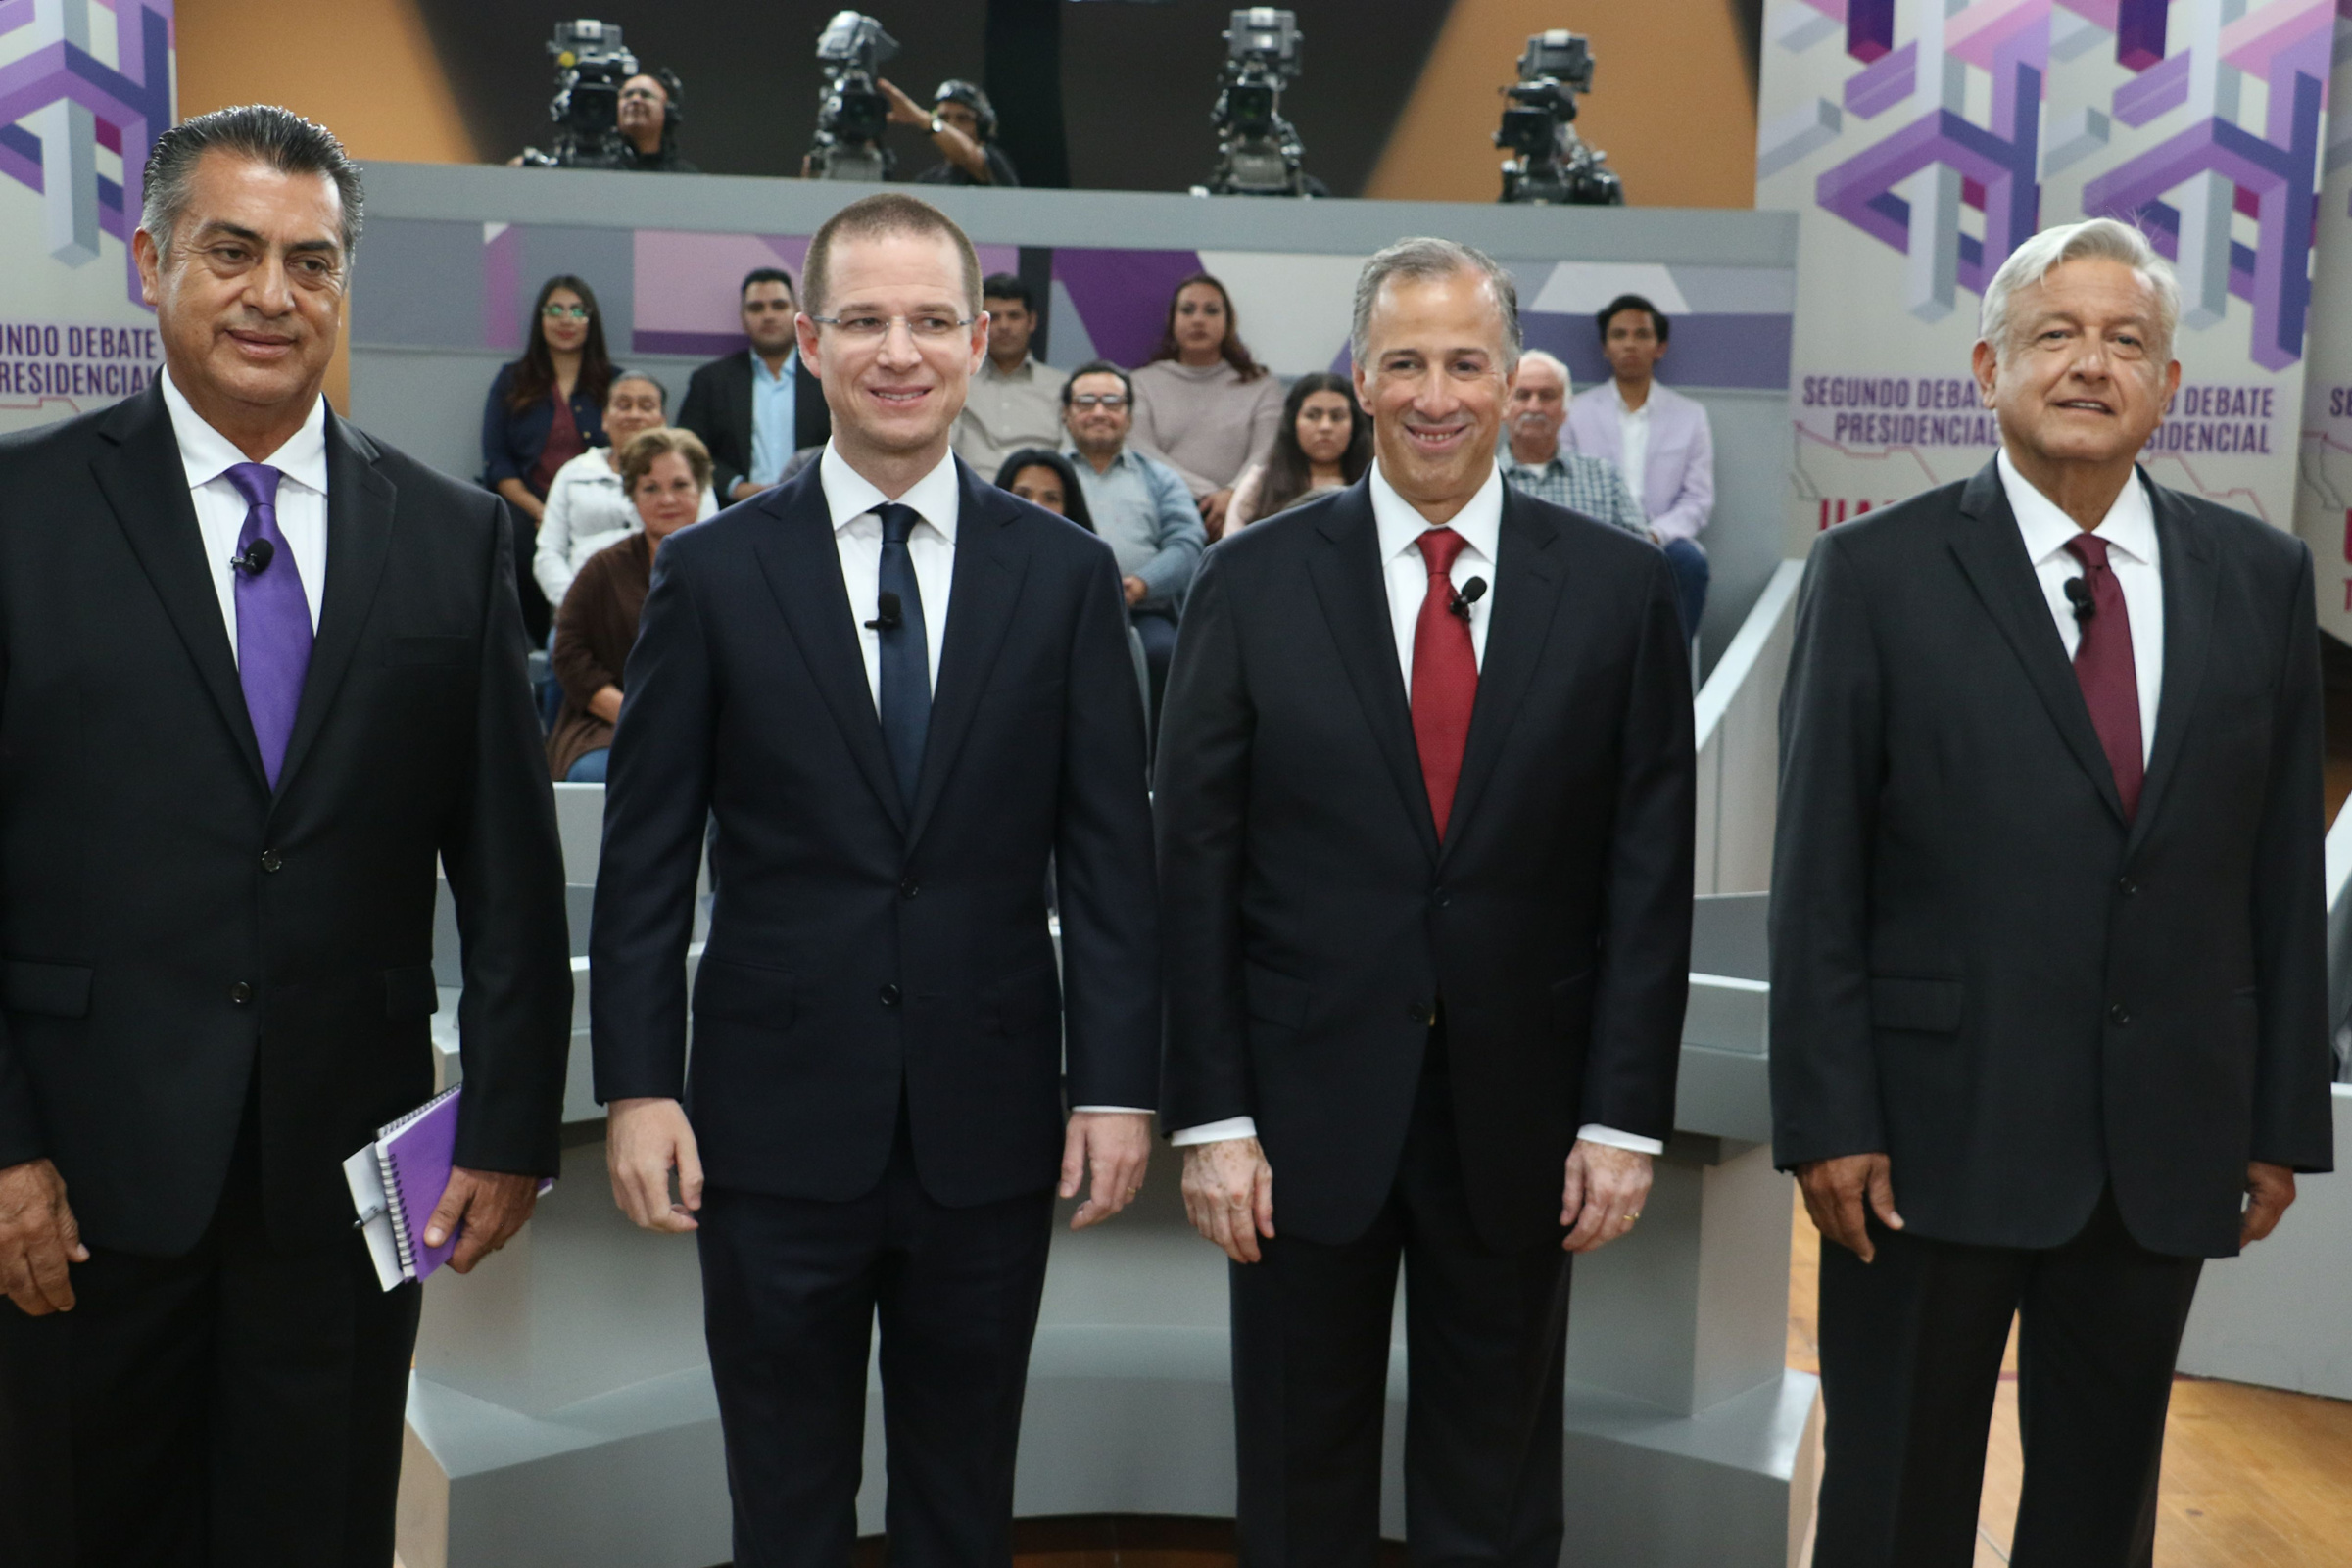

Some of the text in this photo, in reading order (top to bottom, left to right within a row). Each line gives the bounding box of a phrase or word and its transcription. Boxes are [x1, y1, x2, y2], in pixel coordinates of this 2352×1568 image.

[0, 324, 157, 359] NDO DEBATE
[1802, 375, 1984, 409] SEGUNDO DEBA
[2184, 386, 2274, 418] DEBATE
[1835, 412, 1998, 446] PRESIDENCIAL
